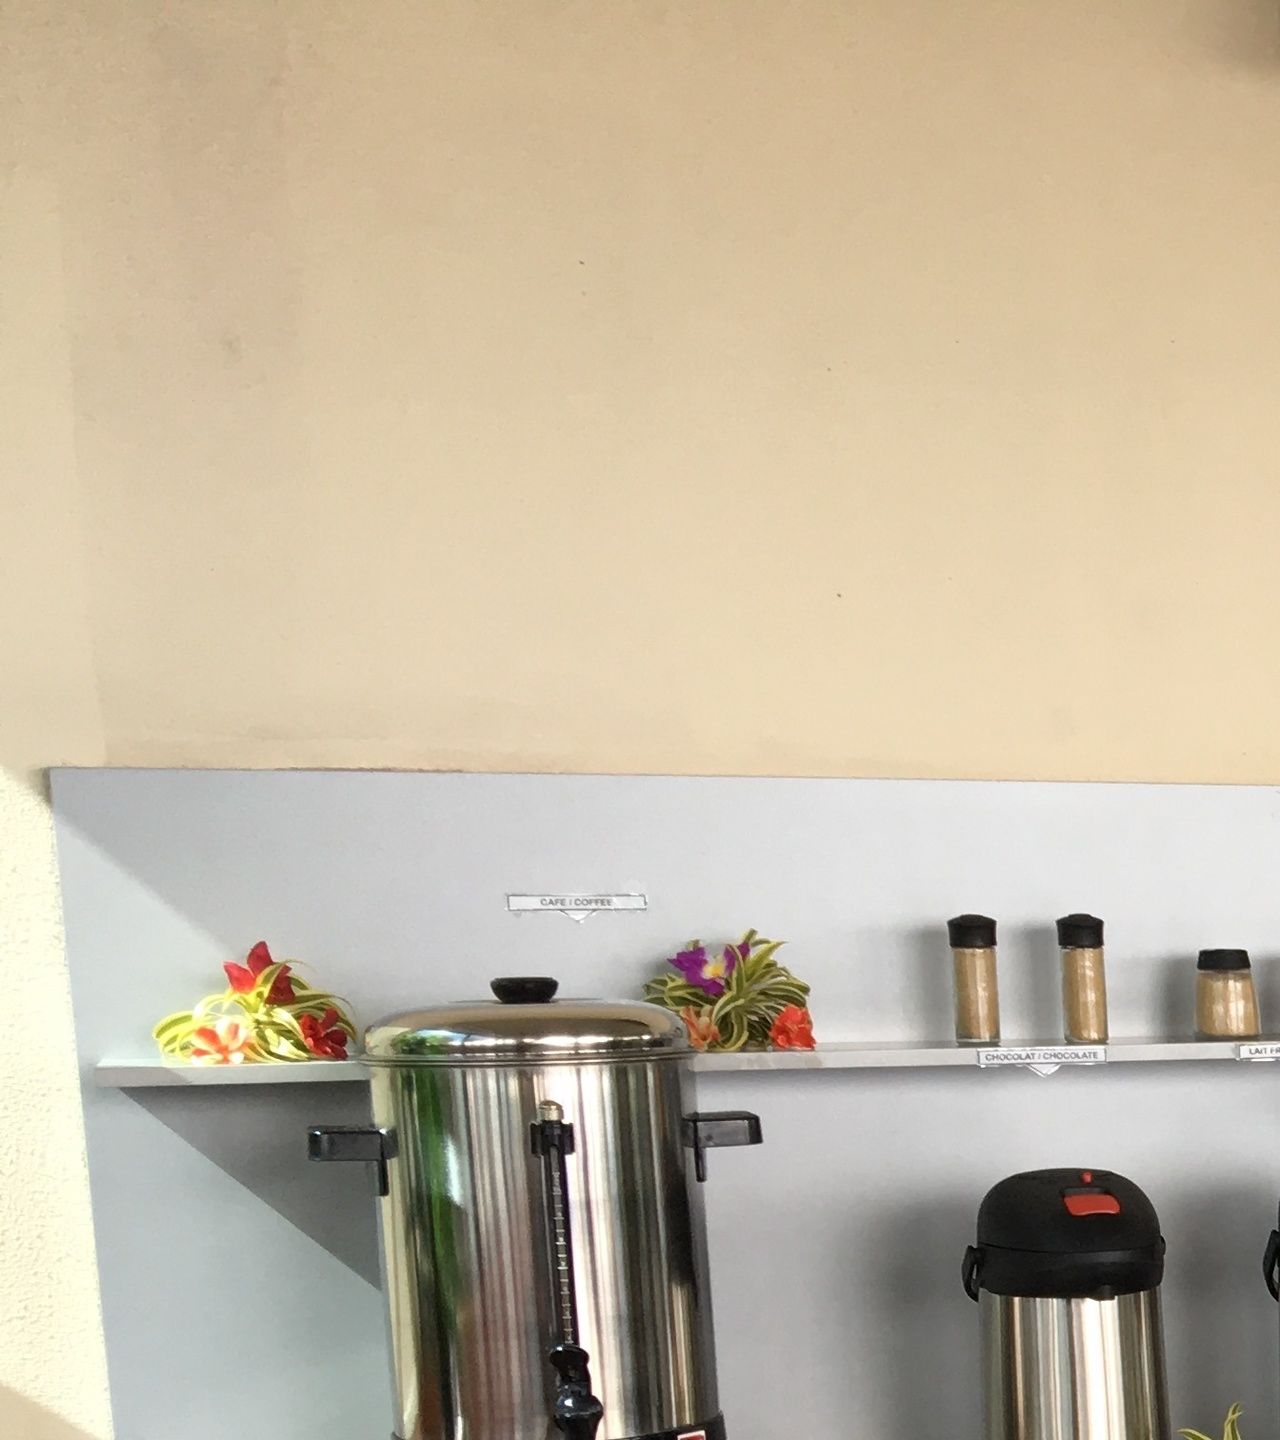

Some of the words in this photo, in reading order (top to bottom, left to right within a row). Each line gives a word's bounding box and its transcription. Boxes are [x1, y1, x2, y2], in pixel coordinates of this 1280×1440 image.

[1249, 1046, 1268, 1055] LAIT
[985, 1052, 1035, 1062] CHOCOLAT
[1042, 1051, 1098, 1060] CHOCOLATE
